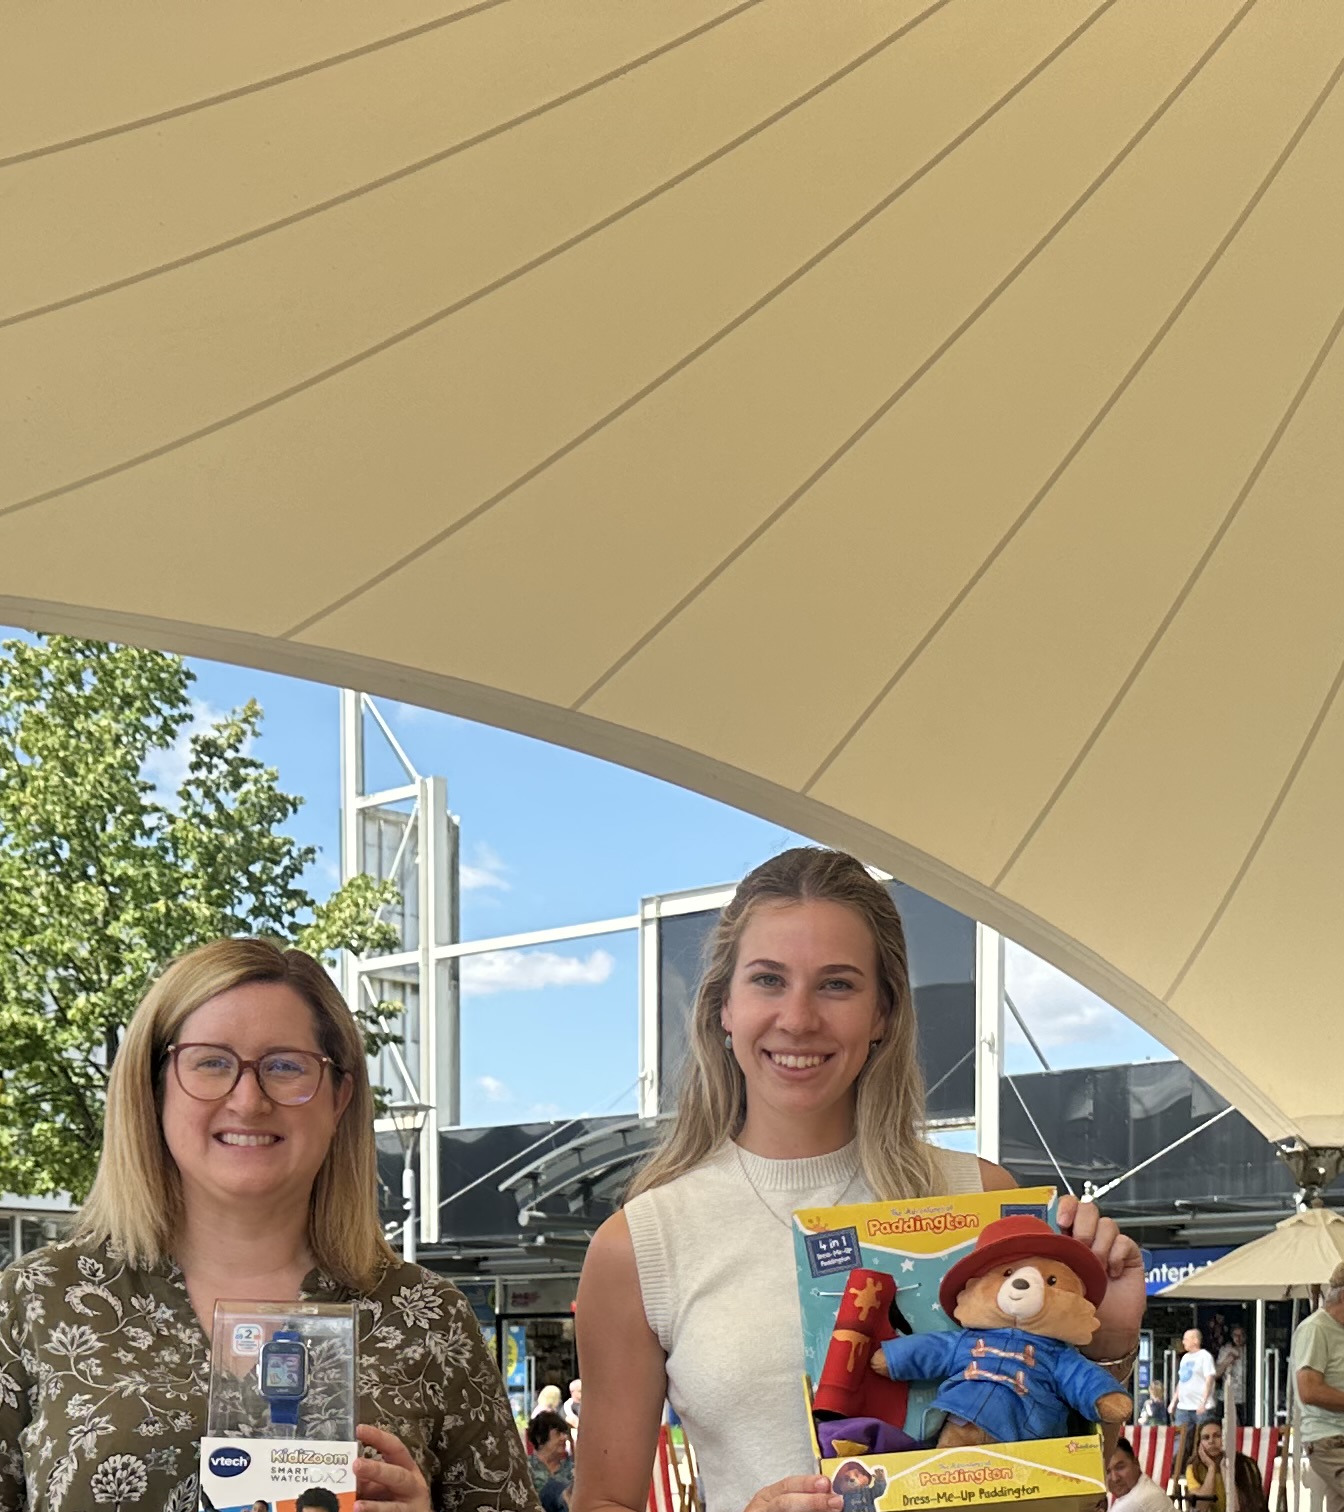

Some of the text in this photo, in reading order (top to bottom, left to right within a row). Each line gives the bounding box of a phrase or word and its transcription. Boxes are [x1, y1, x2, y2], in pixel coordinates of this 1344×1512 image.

[867, 1212, 979, 1237] Paddington
[819, 1239, 827, 1250] 4
[829, 1237, 839, 1248] in
[210, 1456, 248, 1467] vtech
[271, 1448, 348, 1466] KidiZoom
[271, 1467, 309, 1475] SMART
[271, 1475, 309, 1483] WATCH
[309, 1468, 348, 1484] DX2
[919, 1467, 1012, 1486] Paddington
[903, 1485, 1040, 1506] Dress-Me-Up Paddington
